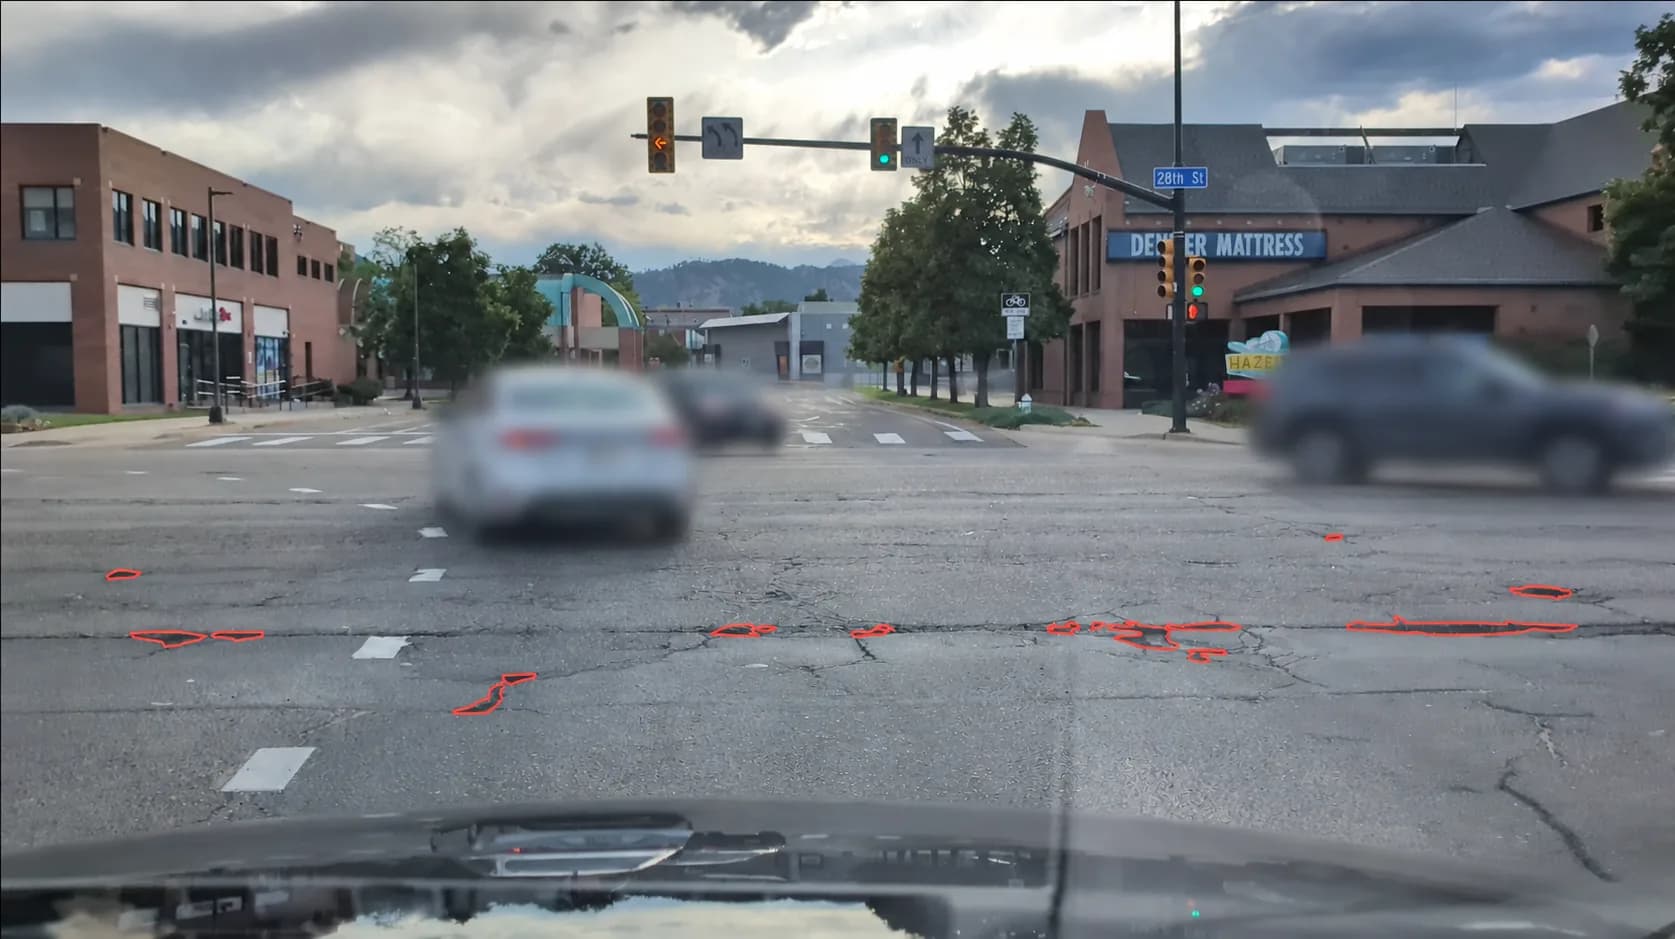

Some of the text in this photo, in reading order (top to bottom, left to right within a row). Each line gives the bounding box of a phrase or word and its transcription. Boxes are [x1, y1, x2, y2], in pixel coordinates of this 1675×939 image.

[904, 155, 928, 165] ONLY
[1157, 171, 1204, 185] 28th St
[1131, 233, 1304, 257] DEER MATTRESS
[1230, 355, 1276, 369] HAZE
